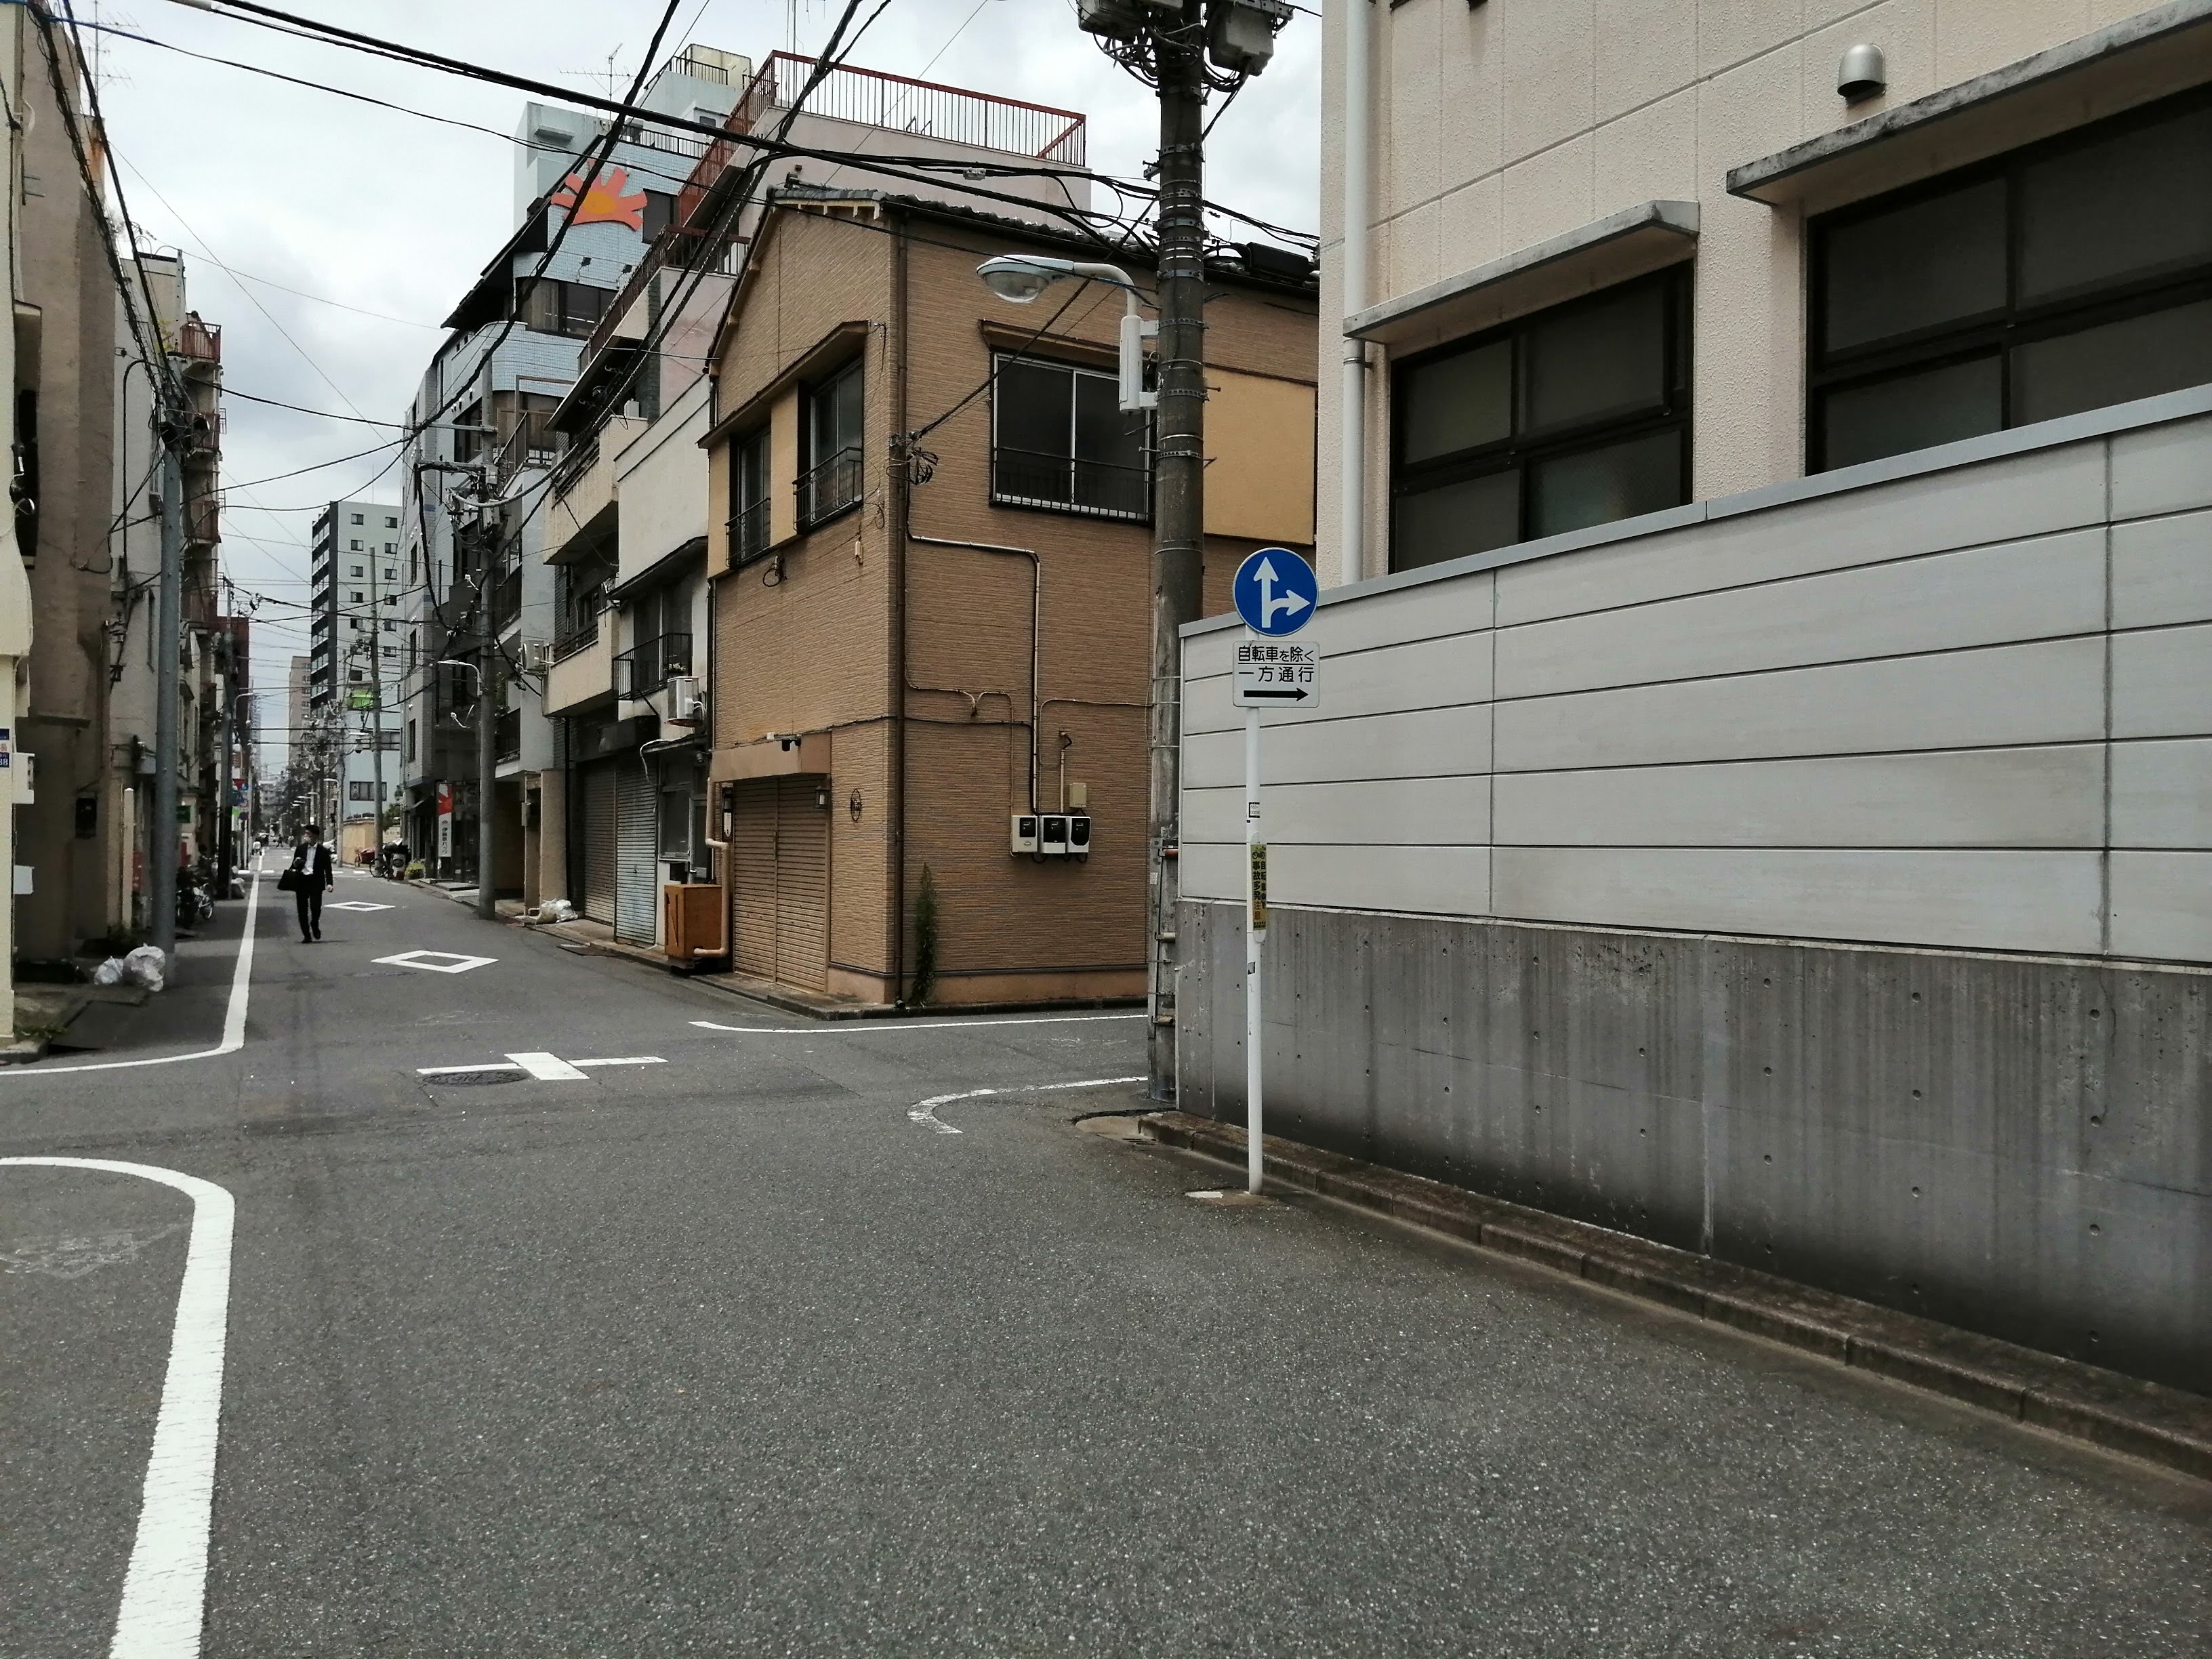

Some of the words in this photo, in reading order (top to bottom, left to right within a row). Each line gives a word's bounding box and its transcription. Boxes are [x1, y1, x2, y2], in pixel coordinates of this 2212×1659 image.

[1238, 645, 1314, 663] 自転車を除く
[1238, 665, 1315, 682] 一方通行
